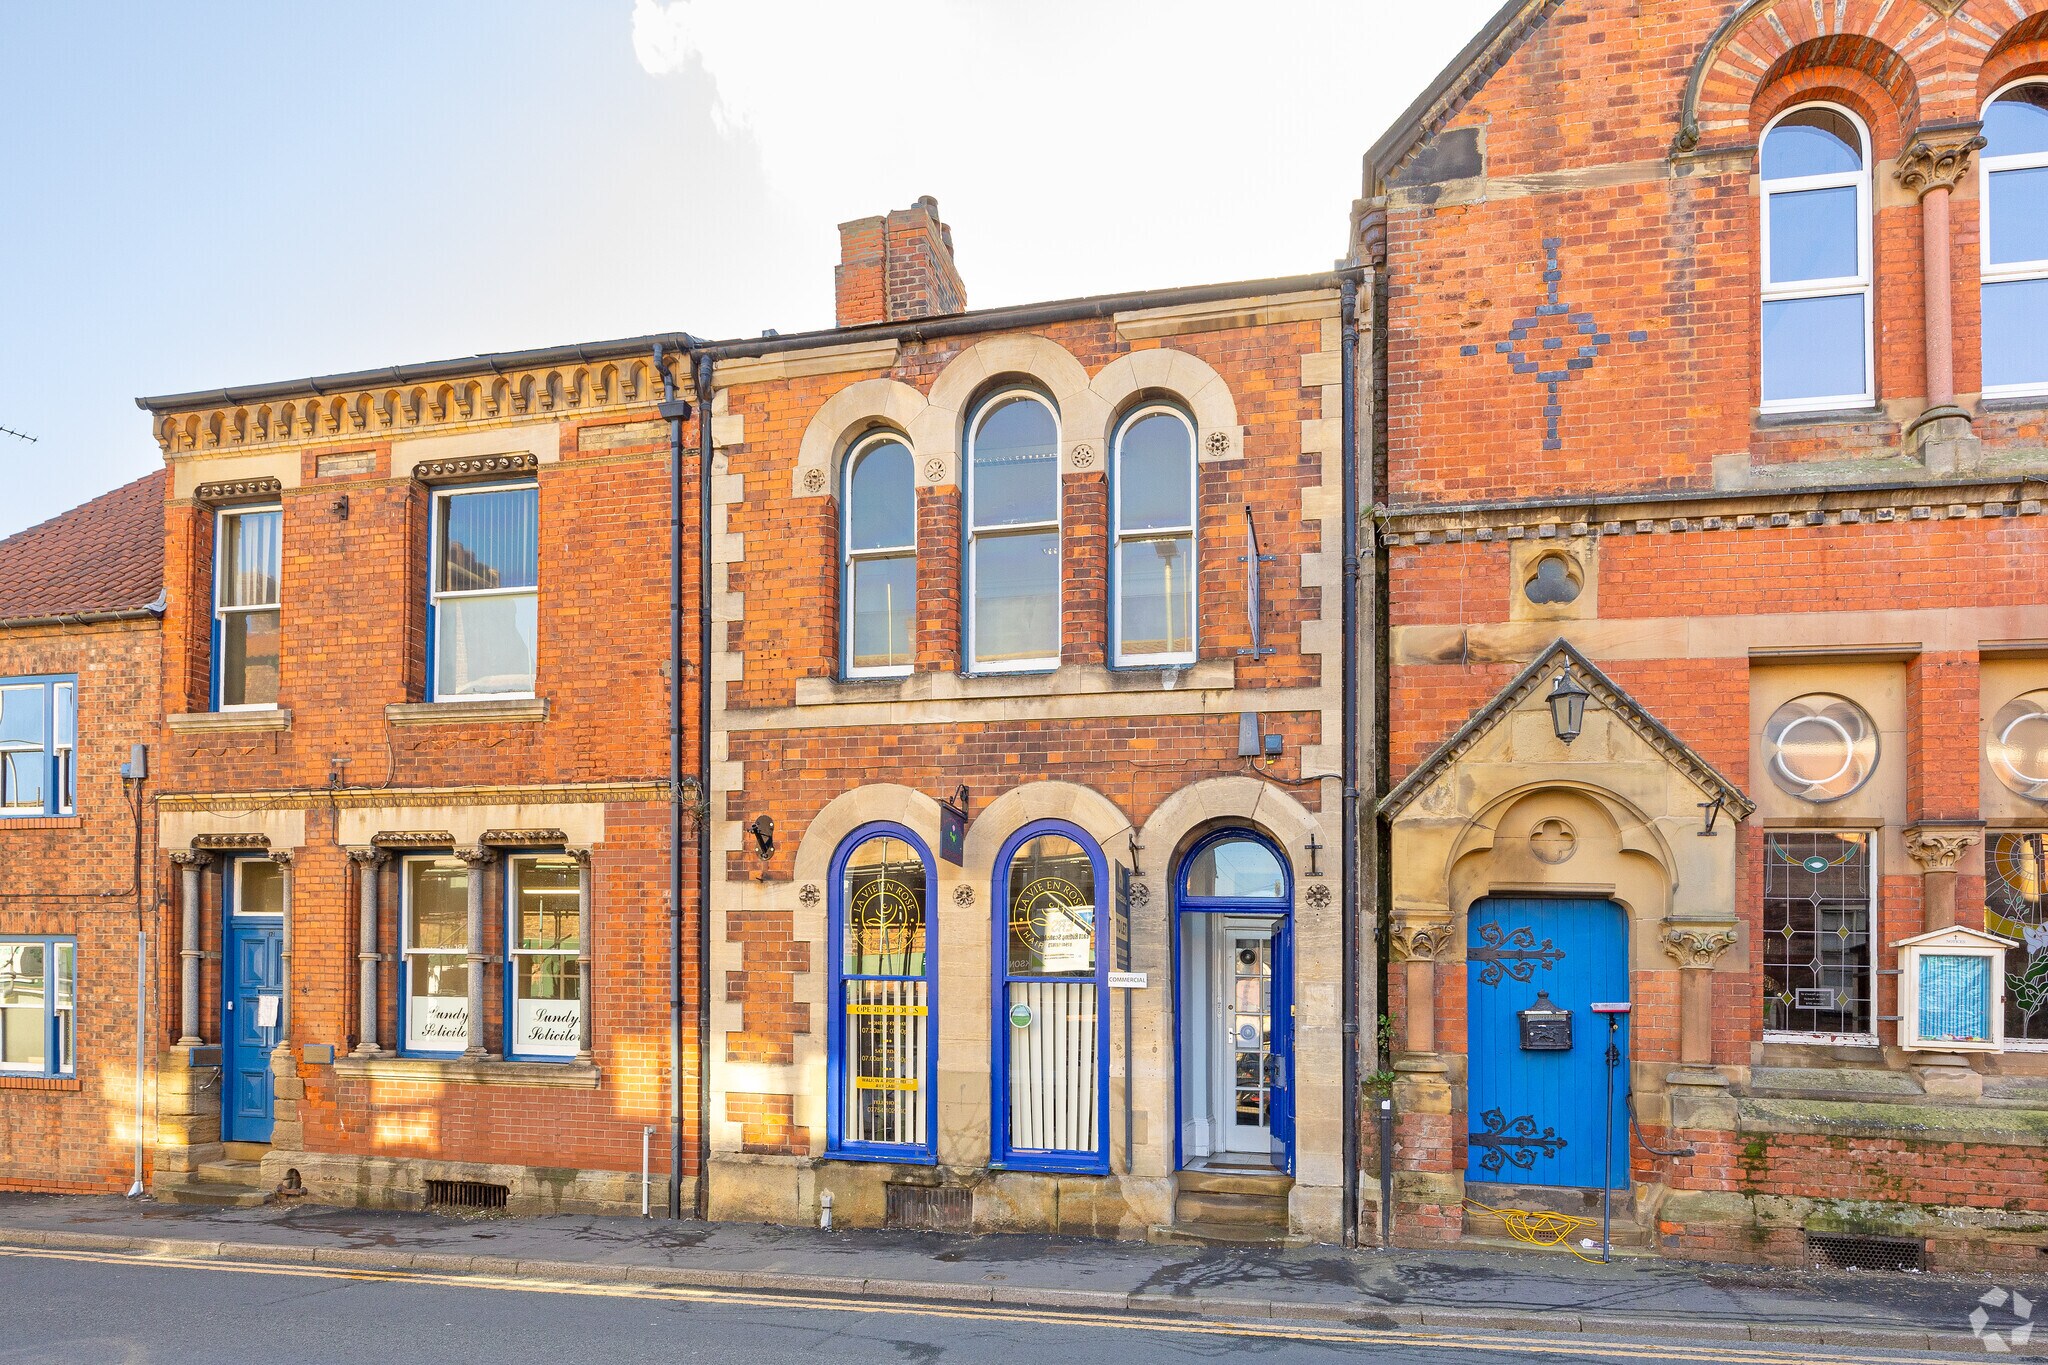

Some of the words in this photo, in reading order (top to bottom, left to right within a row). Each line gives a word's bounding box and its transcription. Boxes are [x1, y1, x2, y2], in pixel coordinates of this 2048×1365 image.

[853, 899, 865, 912] LA
[861, 884, 878, 897] VIE
[896, 886, 915, 910] ROSE
[1018, 898, 1029, 911] LA
[1026, 882, 1044, 897] VIE
[1046, 880, 1061, 890] EN
[1022, 931, 1045, 949] HAIR
[533, 1008, 581, 1028] Lundy
